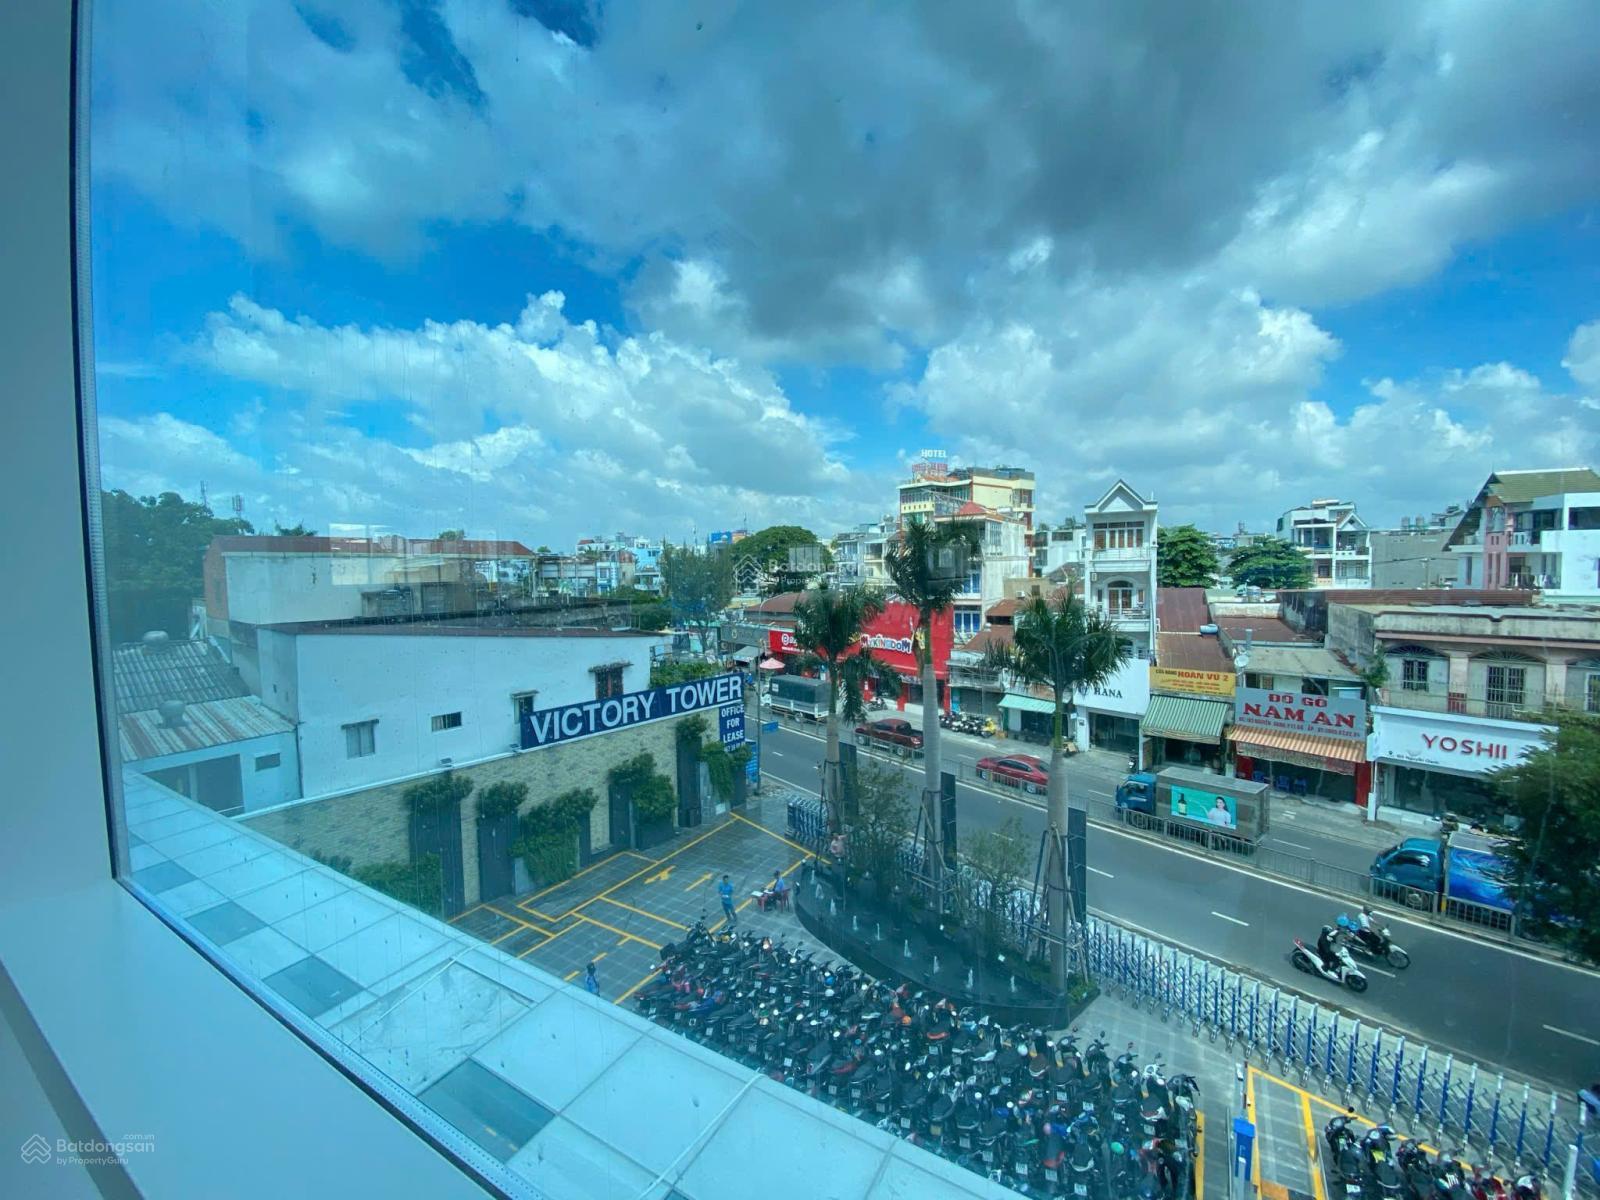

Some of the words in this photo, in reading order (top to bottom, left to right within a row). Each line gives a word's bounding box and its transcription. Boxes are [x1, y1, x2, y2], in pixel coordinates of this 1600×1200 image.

[921, 449, 947, 458] HOTEL
[1223, 674, 1229, 682] 2
[1094, 687, 1123, 699] HANA
[529, 693, 656, 743] VICTORY
[666, 675, 742, 713] TOWER
[721, 704, 745, 718] OFFICE
[1243, 702, 1305, 722] NAM
[1312, 711, 1356, 729] AN
[726, 718, 740, 729] FOR
[723, 730, 744, 743] LEASE
[1422, 733, 1507, 760] YOSHII
